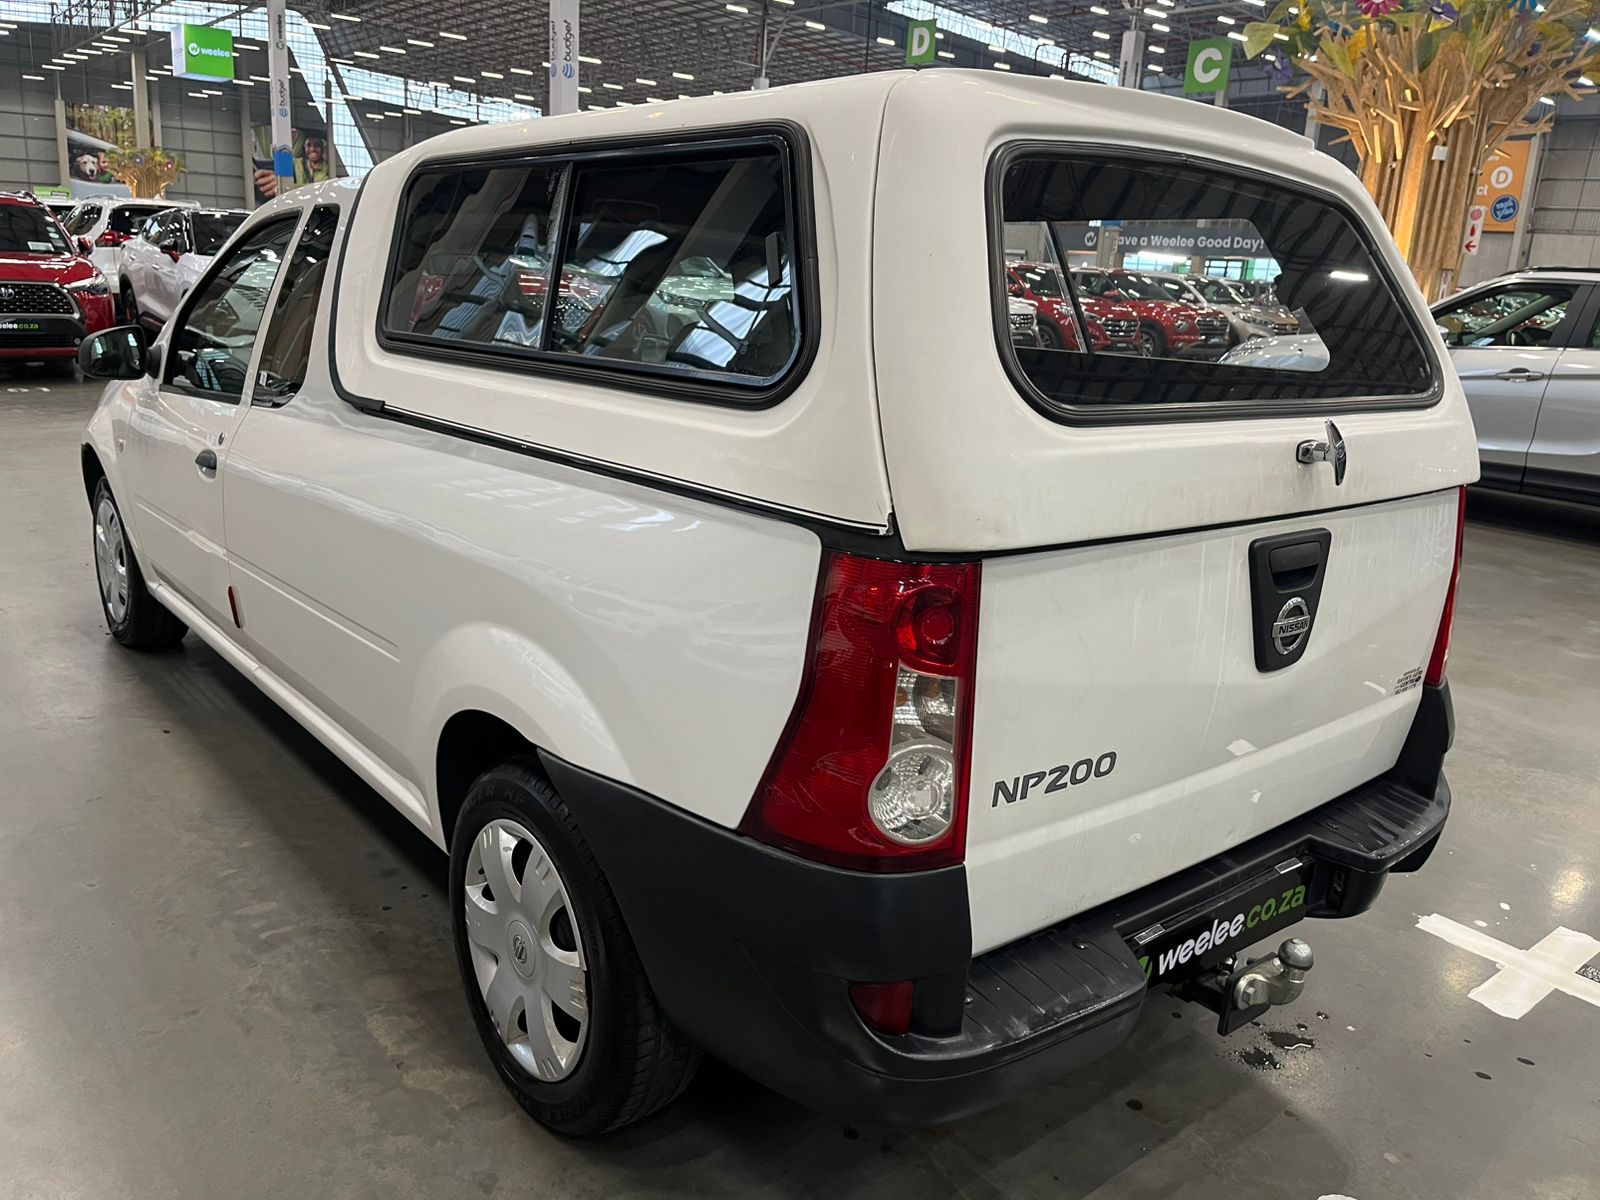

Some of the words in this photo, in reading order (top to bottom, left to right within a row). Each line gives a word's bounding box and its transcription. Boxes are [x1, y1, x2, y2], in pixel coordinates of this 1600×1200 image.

[200, 47, 231, 58] weelee
[562, 19, 575, 61] budget
[911, 26, 931, 57] D
[1193, 47, 1222, 84] C
[278, 79, 288, 107] budget
[1118, 236, 1137, 246] ave
[1140, 236, 1148, 246] a
[1151, 235, 1195, 248] Weelee
[1197, 236, 1232, 249] Good
[1233, 236, 1265, 252] Day!
[1278, 621, 1308, 635] NISSAN
[991, 751, 1117, 808] NP200
[1158, 884, 1306, 976] weelee.co.za
